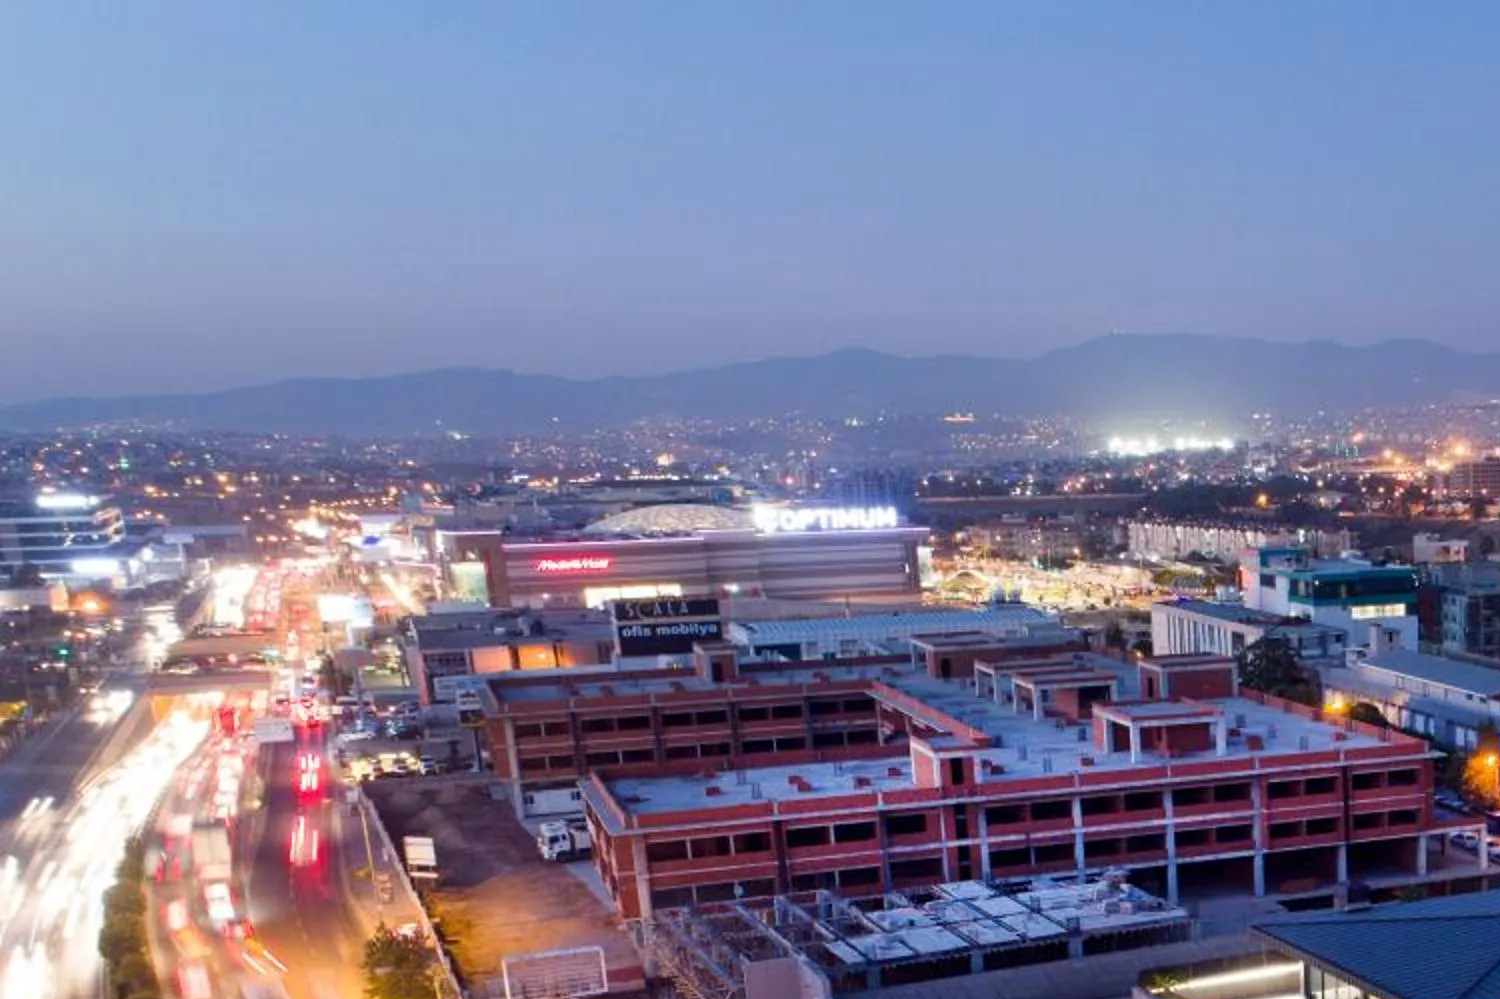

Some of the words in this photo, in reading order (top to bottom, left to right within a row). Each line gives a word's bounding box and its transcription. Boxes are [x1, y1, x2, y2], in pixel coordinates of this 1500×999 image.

[779, 505, 898, 531] OPTIMUM
[625, 600, 689, 618] SCALA
[621, 624, 652, 638] ofis
[656, 621, 718, 637] mobilya
